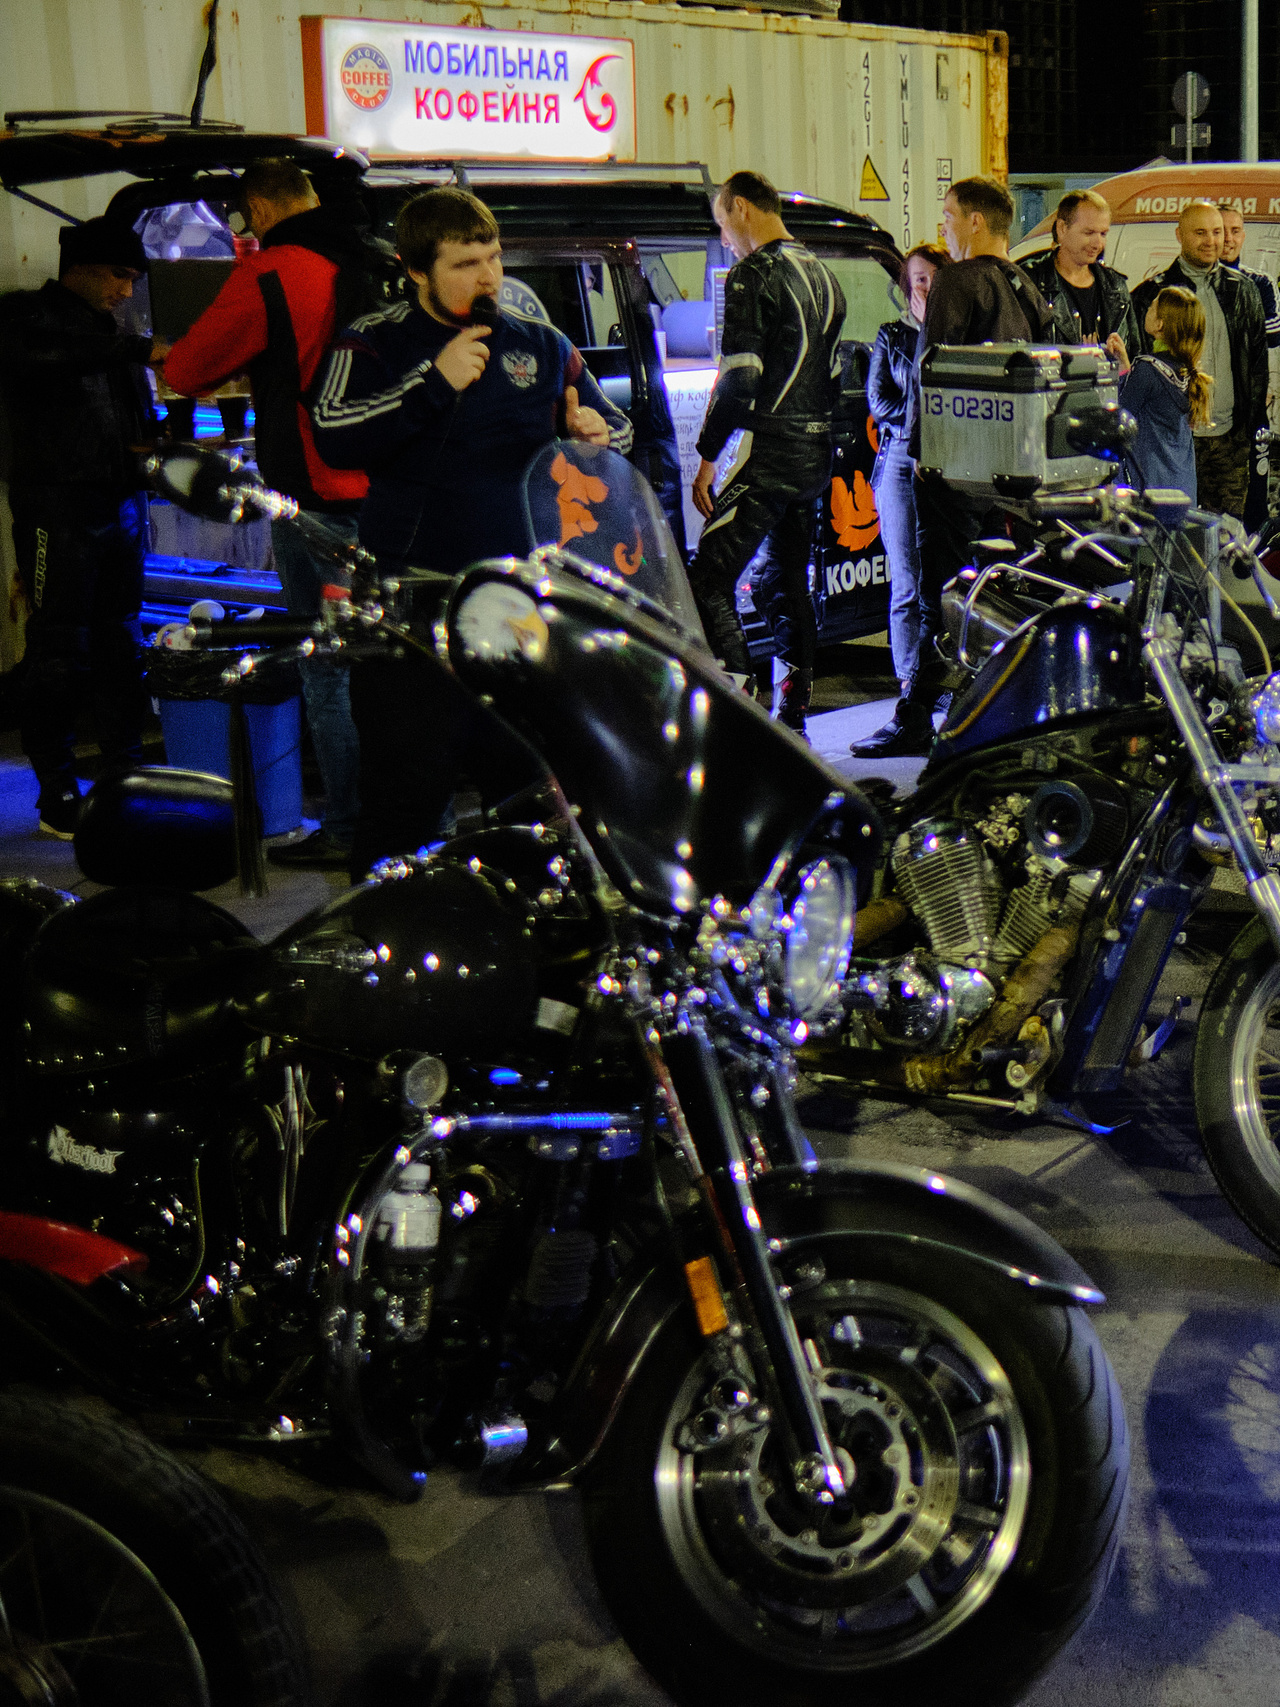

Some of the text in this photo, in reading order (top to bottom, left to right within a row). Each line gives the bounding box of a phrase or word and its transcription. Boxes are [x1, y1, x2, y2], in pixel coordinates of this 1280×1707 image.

[348, 49, 384, 66] MAGIC
[403, 39, 570, 82] МОБИЛЬНАЯ
[342, 71, 391, 87] COFFEE
[351, 93, 384, 107] CLUB
[413, 82, 561, 124] КОФЕЙНЯ
[900, 53, 909, 149] YMLU
[503, 286, 537, 315] GIC
[925, 393, 1014, 422] 13-02313
